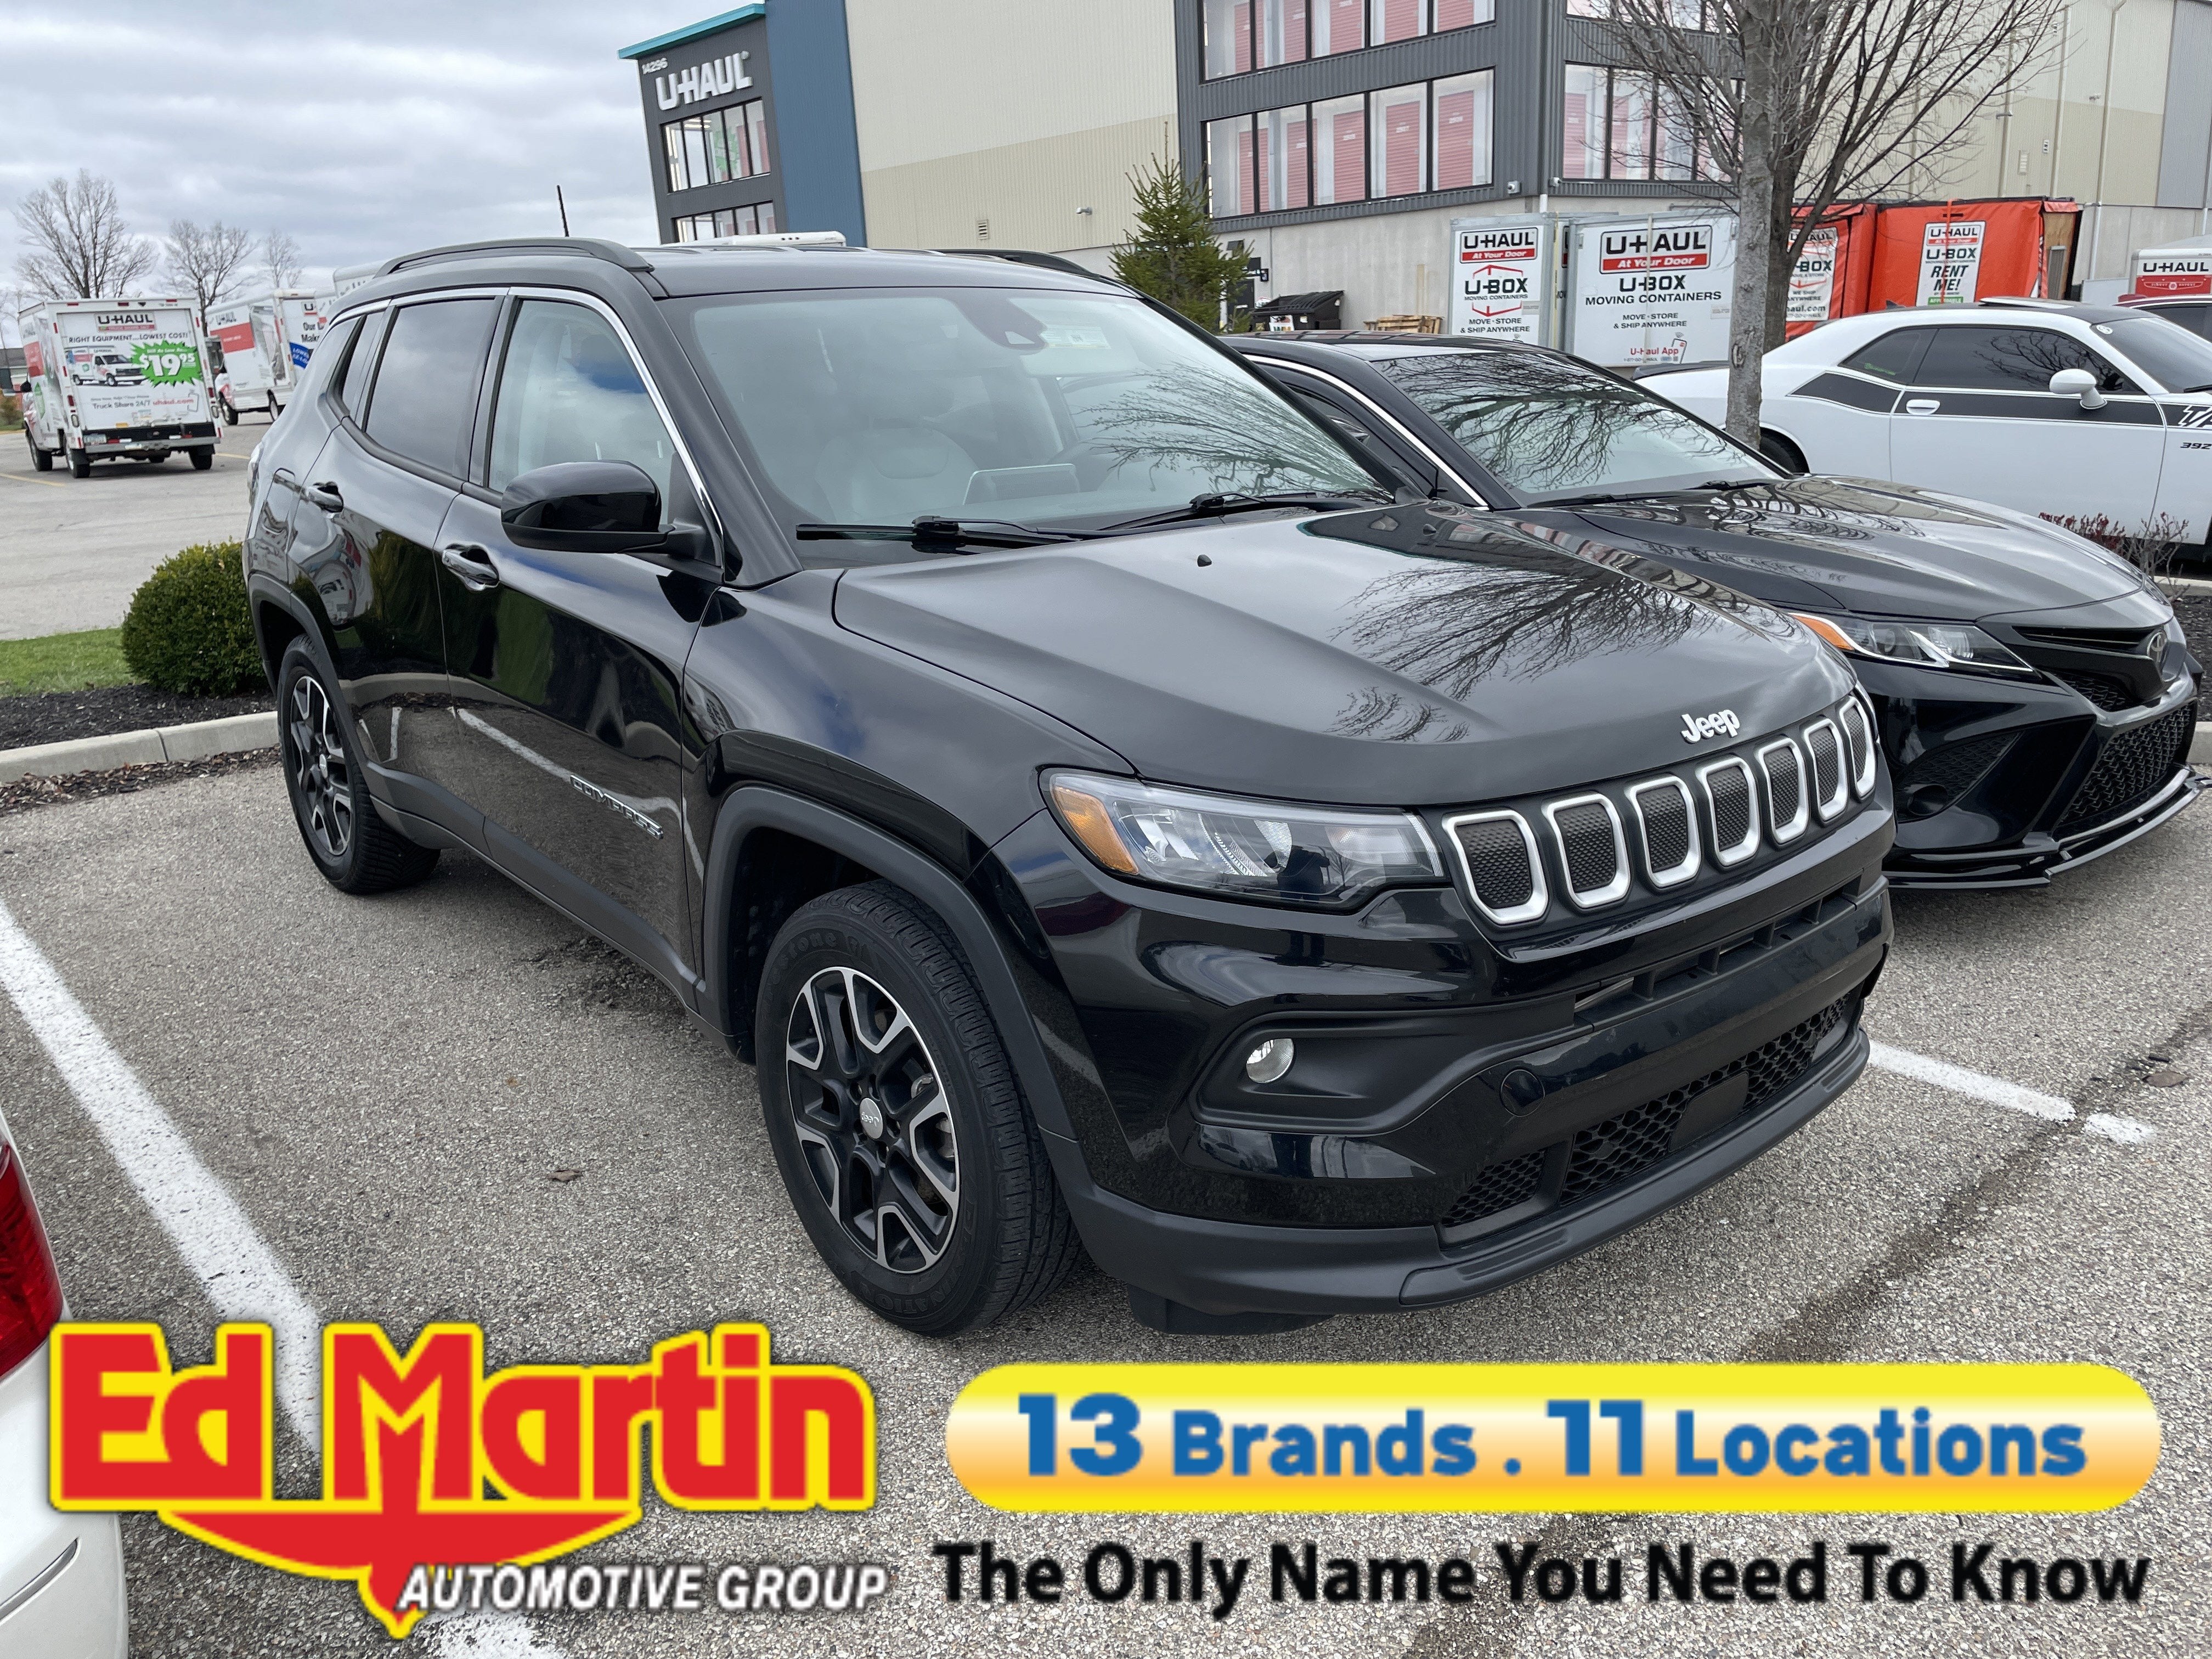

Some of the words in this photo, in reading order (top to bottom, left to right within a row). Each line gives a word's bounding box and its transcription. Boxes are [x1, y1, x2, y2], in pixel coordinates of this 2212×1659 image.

[655, 53, 753, 110] U-HAUL
[1464, 232, 1534, 249] U-HAUL
[1606, 232, 1706, 255] U-HAUL
[1926, 248, 1977, 259] U-BOX
[1634, 258, 1661, 267] Your
[1664, 257, 1695, 266] Door
[1795, 260, 1832, 272] -BOX
[2143, 262, 2209, 273] U-HAUL
[1931, 266, 1969, 278] RENT
[1465, 278, 1528, 295] U-BOX
[1620, 275, 1686, 292] U-BOX
[1933, 279, 1961, 291] ME!
[1585, 295, 1634, 305] MOVING
[1639, 291, 1722, 302] CONTAINERS
[98, 314, 153, 324] U-HAUL
[1661, 347, 1679, 356] App
[1681, 709, 1740, 743] Jeep
